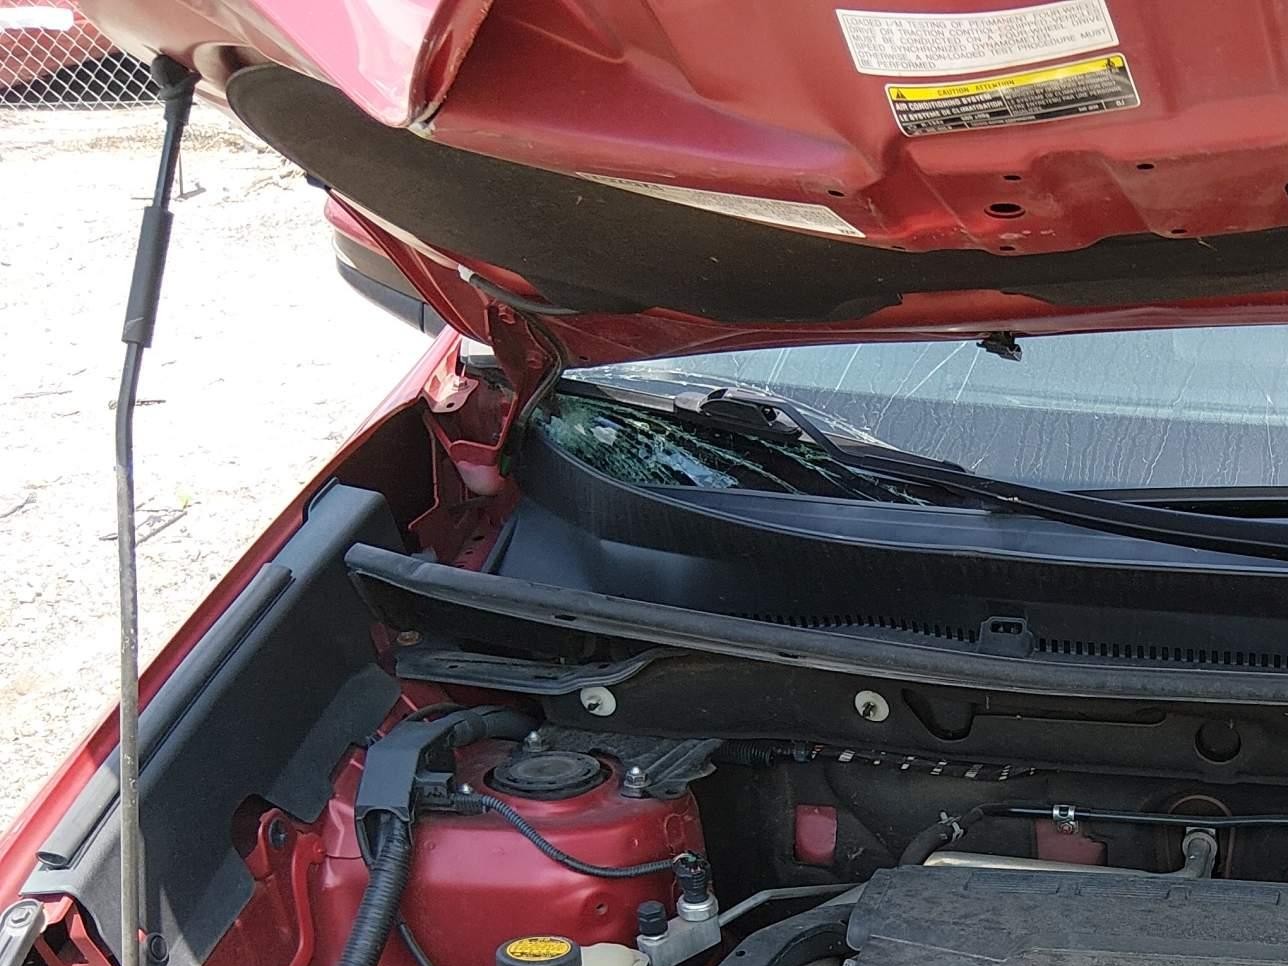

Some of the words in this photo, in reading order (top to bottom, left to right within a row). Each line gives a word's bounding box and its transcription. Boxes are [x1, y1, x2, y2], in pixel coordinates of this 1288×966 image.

[936, 87, 970, 97] CAUTION
[975, 79, 1015, 92] ATTENTION
[895, 102, 908, 111] AIR
[908, 99, 961, 111] CONDITIONING
